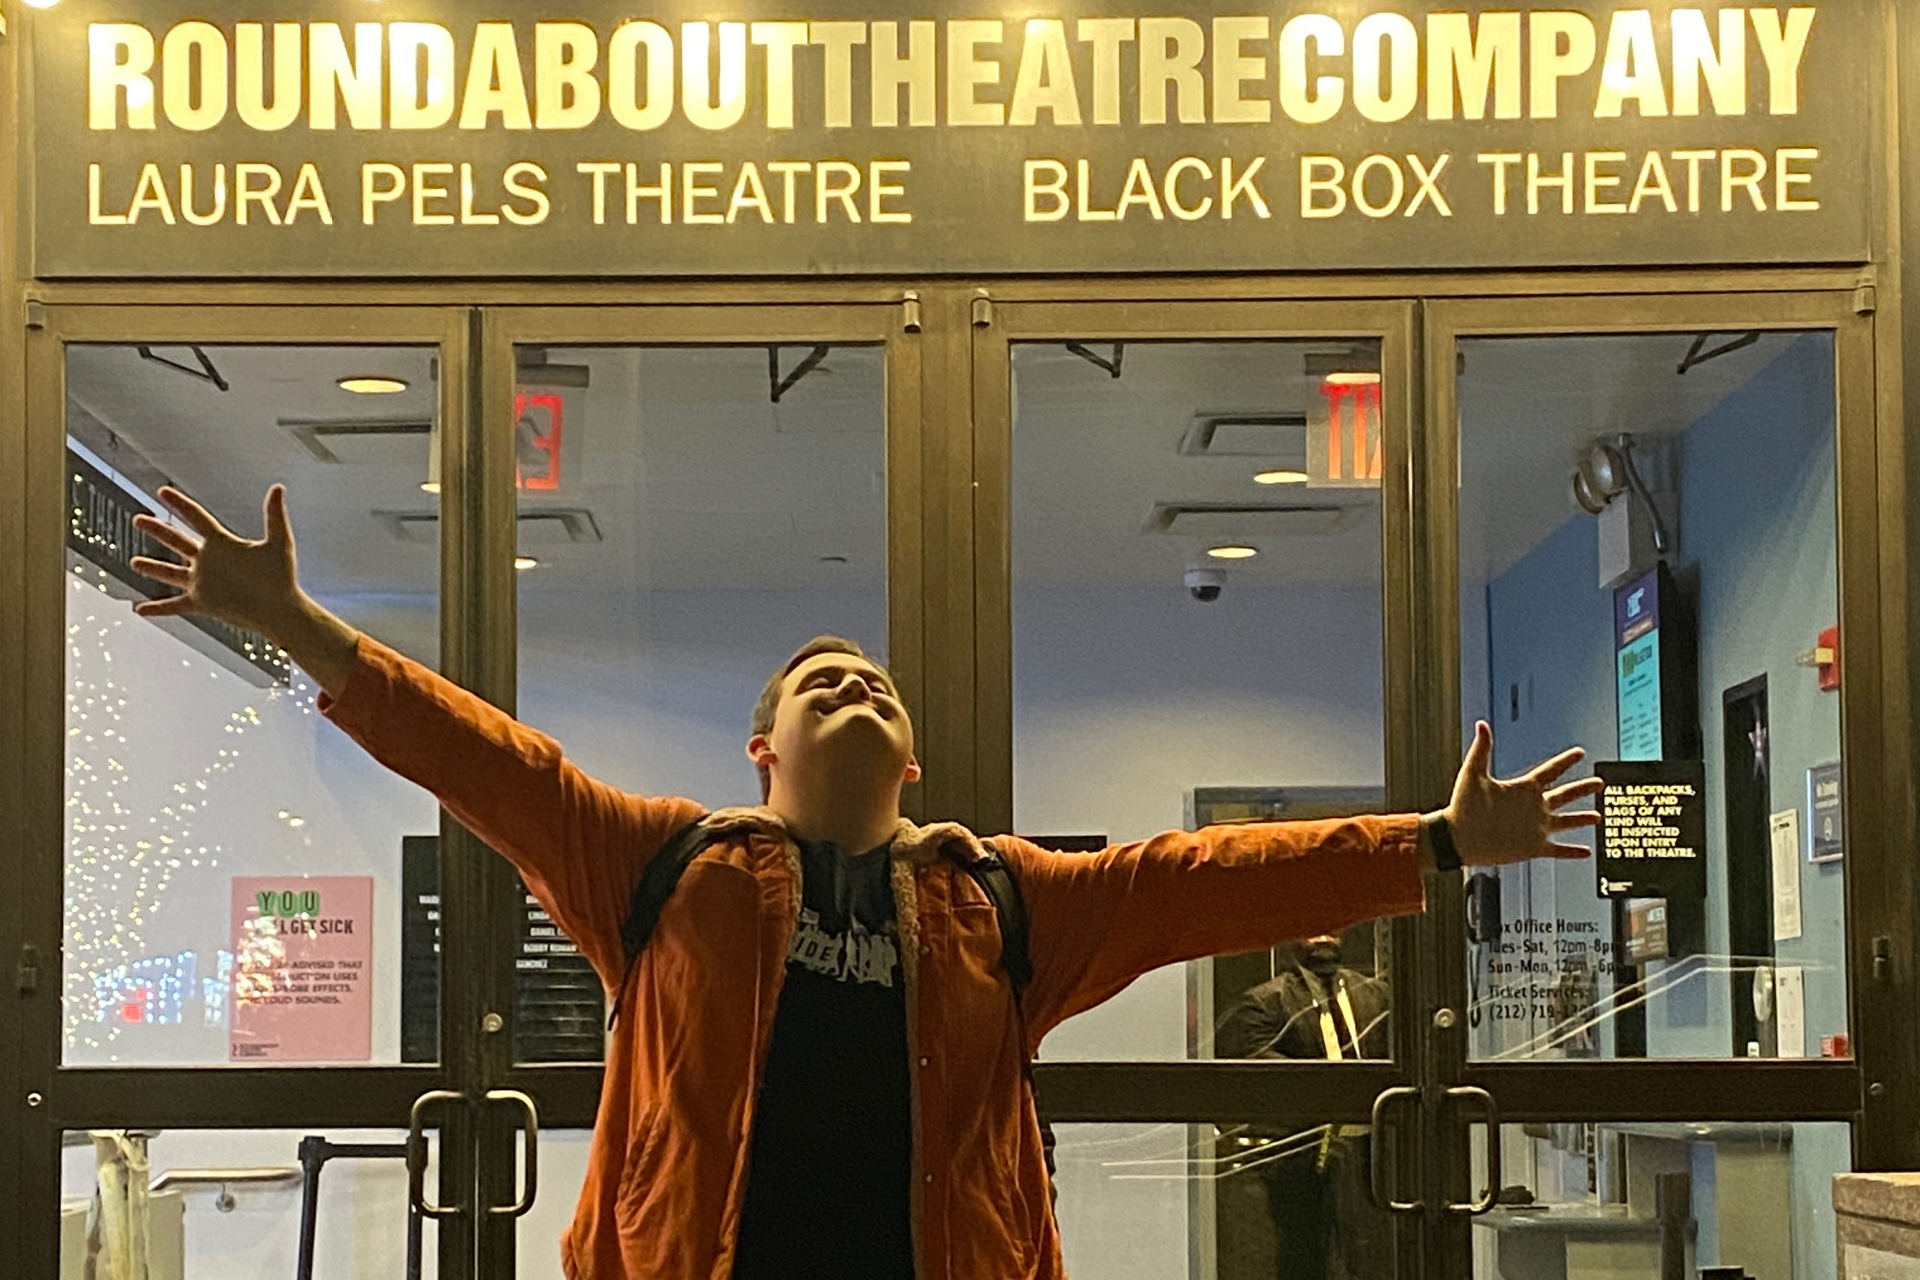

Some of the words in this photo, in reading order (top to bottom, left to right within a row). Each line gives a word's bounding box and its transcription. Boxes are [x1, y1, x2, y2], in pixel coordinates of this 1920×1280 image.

[1023, 157, 1270, 222] BLACK
[1300, 153, 1453, 218] BOX
[1477, 148, 1820, 216] THEATRE
[88, 163, 333, 225] LAURA
[362, 162, 550, 225] PELS
[576, 160, 912, 225] THEATRE
[1604, 785, 1623, 795] ALL
[1626, 785, 1696, 796] BACKPACKS,
[1604, 796, 1649, 806] PURSES,
[1652, 796, 1678, 805] AND
[1605, 806, 1636, 816] BAGS
[1638, 806, 1654, 816] OF
[1657, 806, 1682, 816] ANY
[1605, 817, 1634, 826] KIND
[1636, 817, 1663, 826] WILL
[1605, 828, 1618, 837] BE
[1622, 827, 1680, 836] INSPECTED
[1606, 838, 1639, 847] UPON
[1642, 838, 1677, 847] ENTRY
[1606, 848, 1621, 858] TO
[1624, 848, 1644, 858] THE
[1647, 848, 1696, 858] THEATRE.
[261, 890, 316, 912] YOU
[320, 919, 354, 934] SICK
[1556, 918, 1599, 933] Hours:
[1489, 984, 1527, 998] Ticket
[1489, 1004, 1526, 1021] (212)
